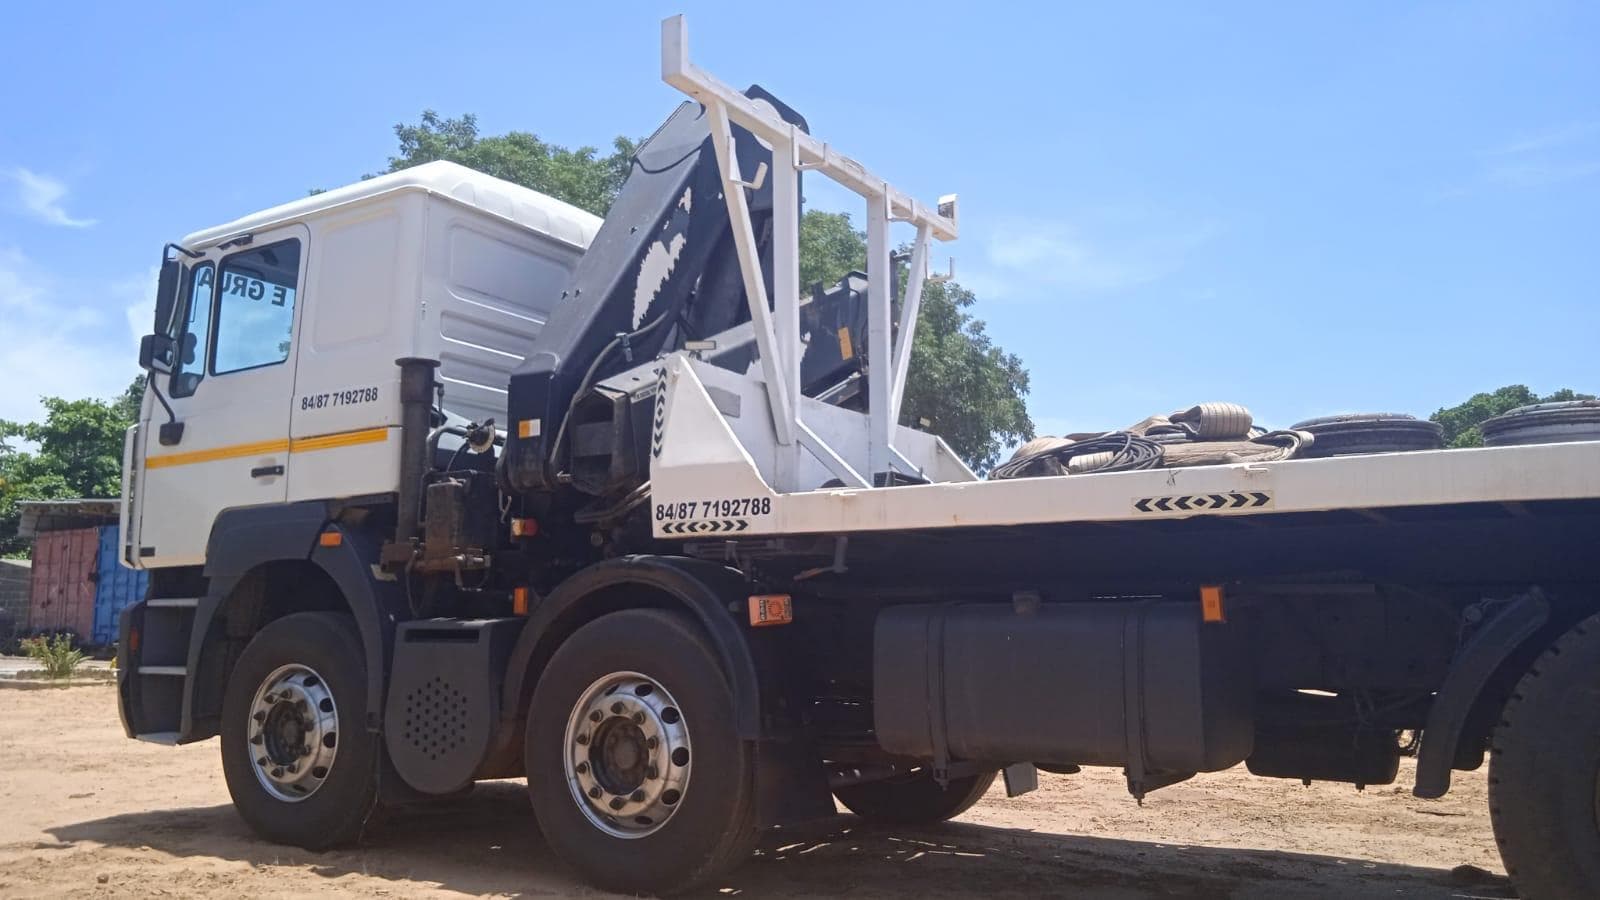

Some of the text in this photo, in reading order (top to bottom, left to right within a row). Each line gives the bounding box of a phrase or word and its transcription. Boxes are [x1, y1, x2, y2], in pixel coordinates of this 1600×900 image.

[301, 387, 378, 410] 84/87 7192788
[656, 497, 771, 521] 84/87 7192788
